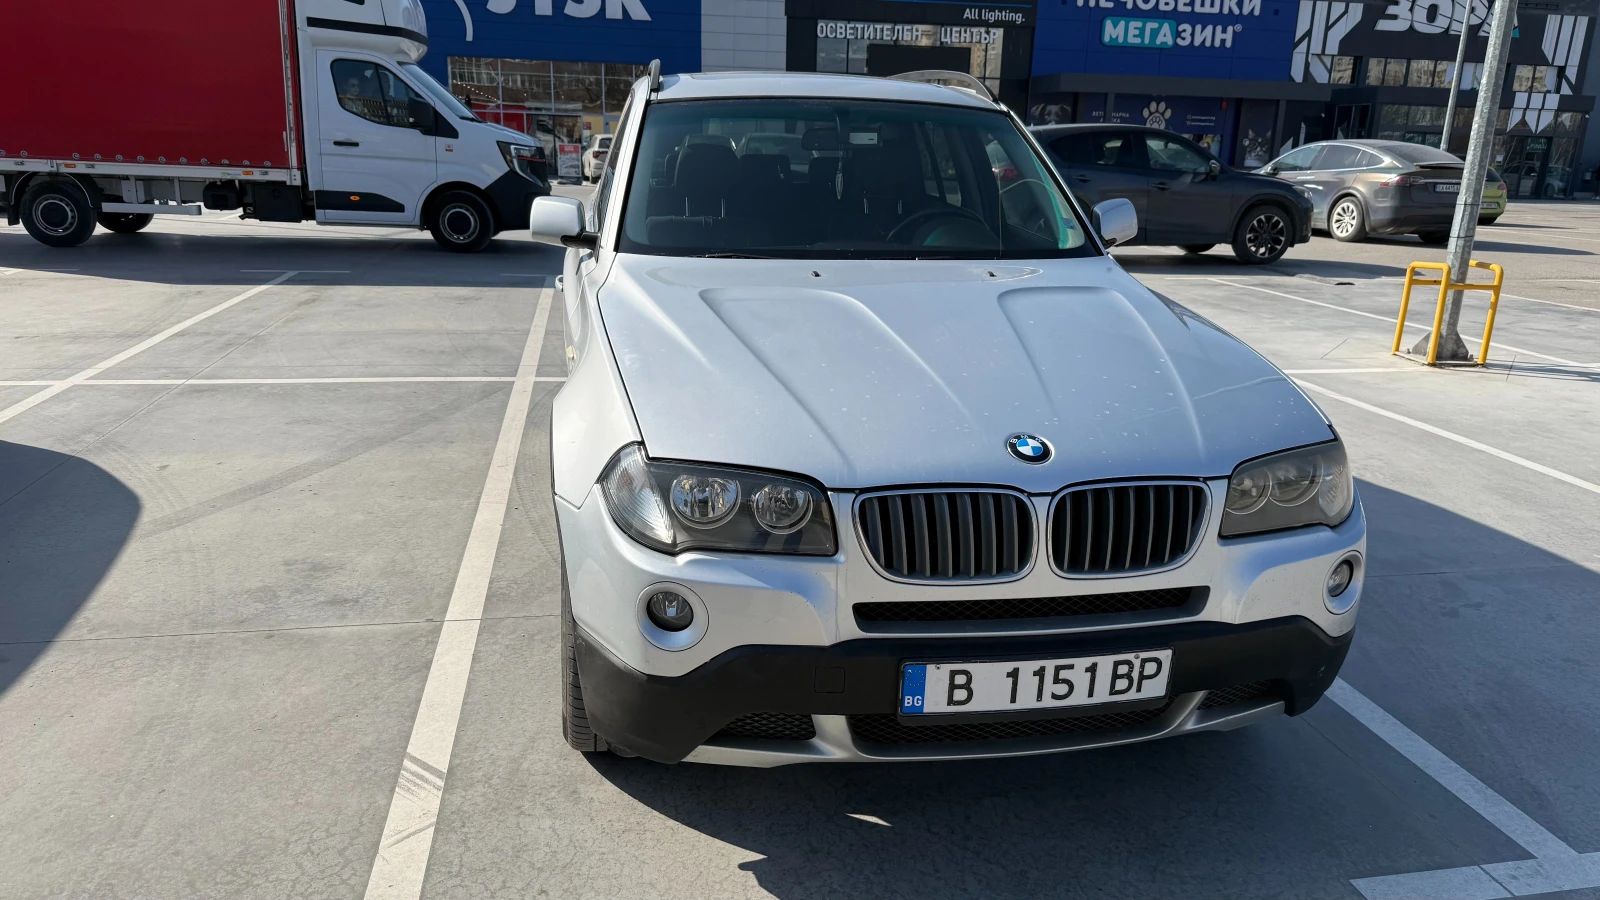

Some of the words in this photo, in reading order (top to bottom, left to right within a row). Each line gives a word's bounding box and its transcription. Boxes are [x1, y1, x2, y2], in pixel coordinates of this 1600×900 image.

[963, 8, 979, 20] All
[981, 9, 1026, 24] lighting.
[816, 22, 922, 41] ОСВЕТИТЕЛЕН
[940, 27, 1000, 44] ЦЕНТЪР
[946, 669, 974, 707] B
[904, 695, 922, 707] BG
